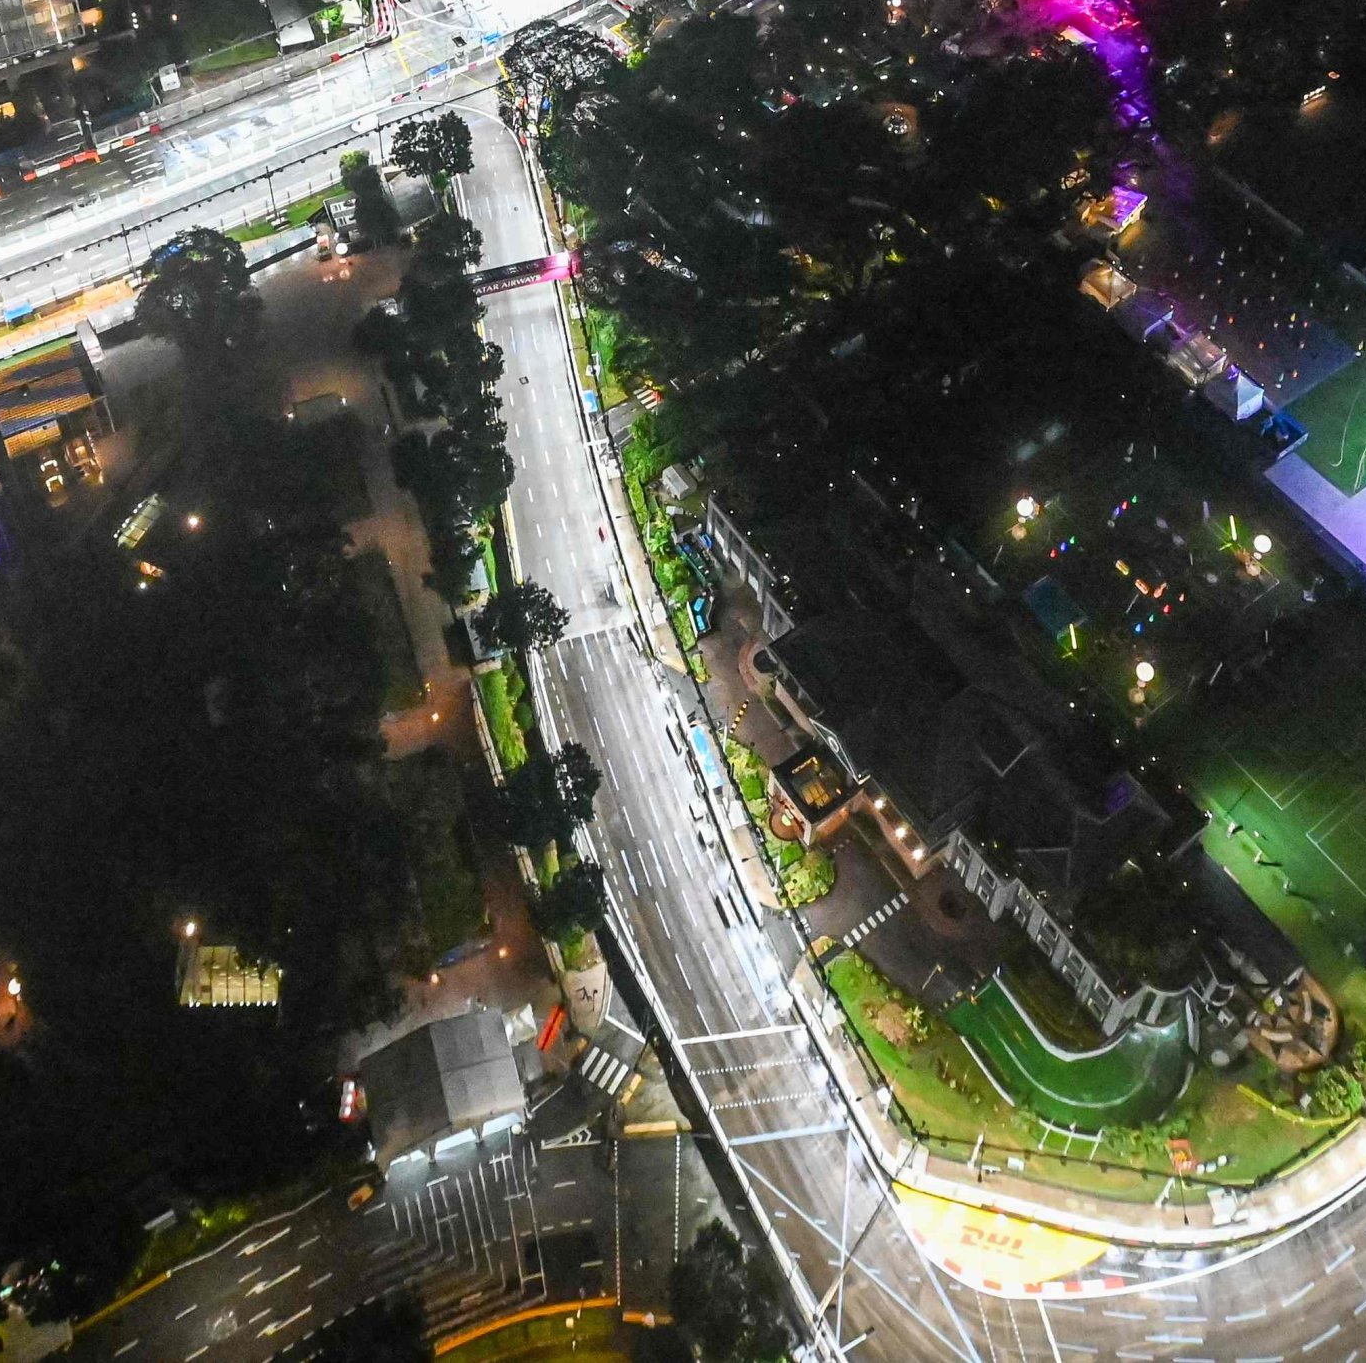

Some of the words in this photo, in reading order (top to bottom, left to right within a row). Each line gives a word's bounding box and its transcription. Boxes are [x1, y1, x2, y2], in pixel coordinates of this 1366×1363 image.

[473, 283, 499, 295] ATAR
[501, 275, 541, 288] AIRWAYS
[960, 1225, 1024, 1250] DHL
